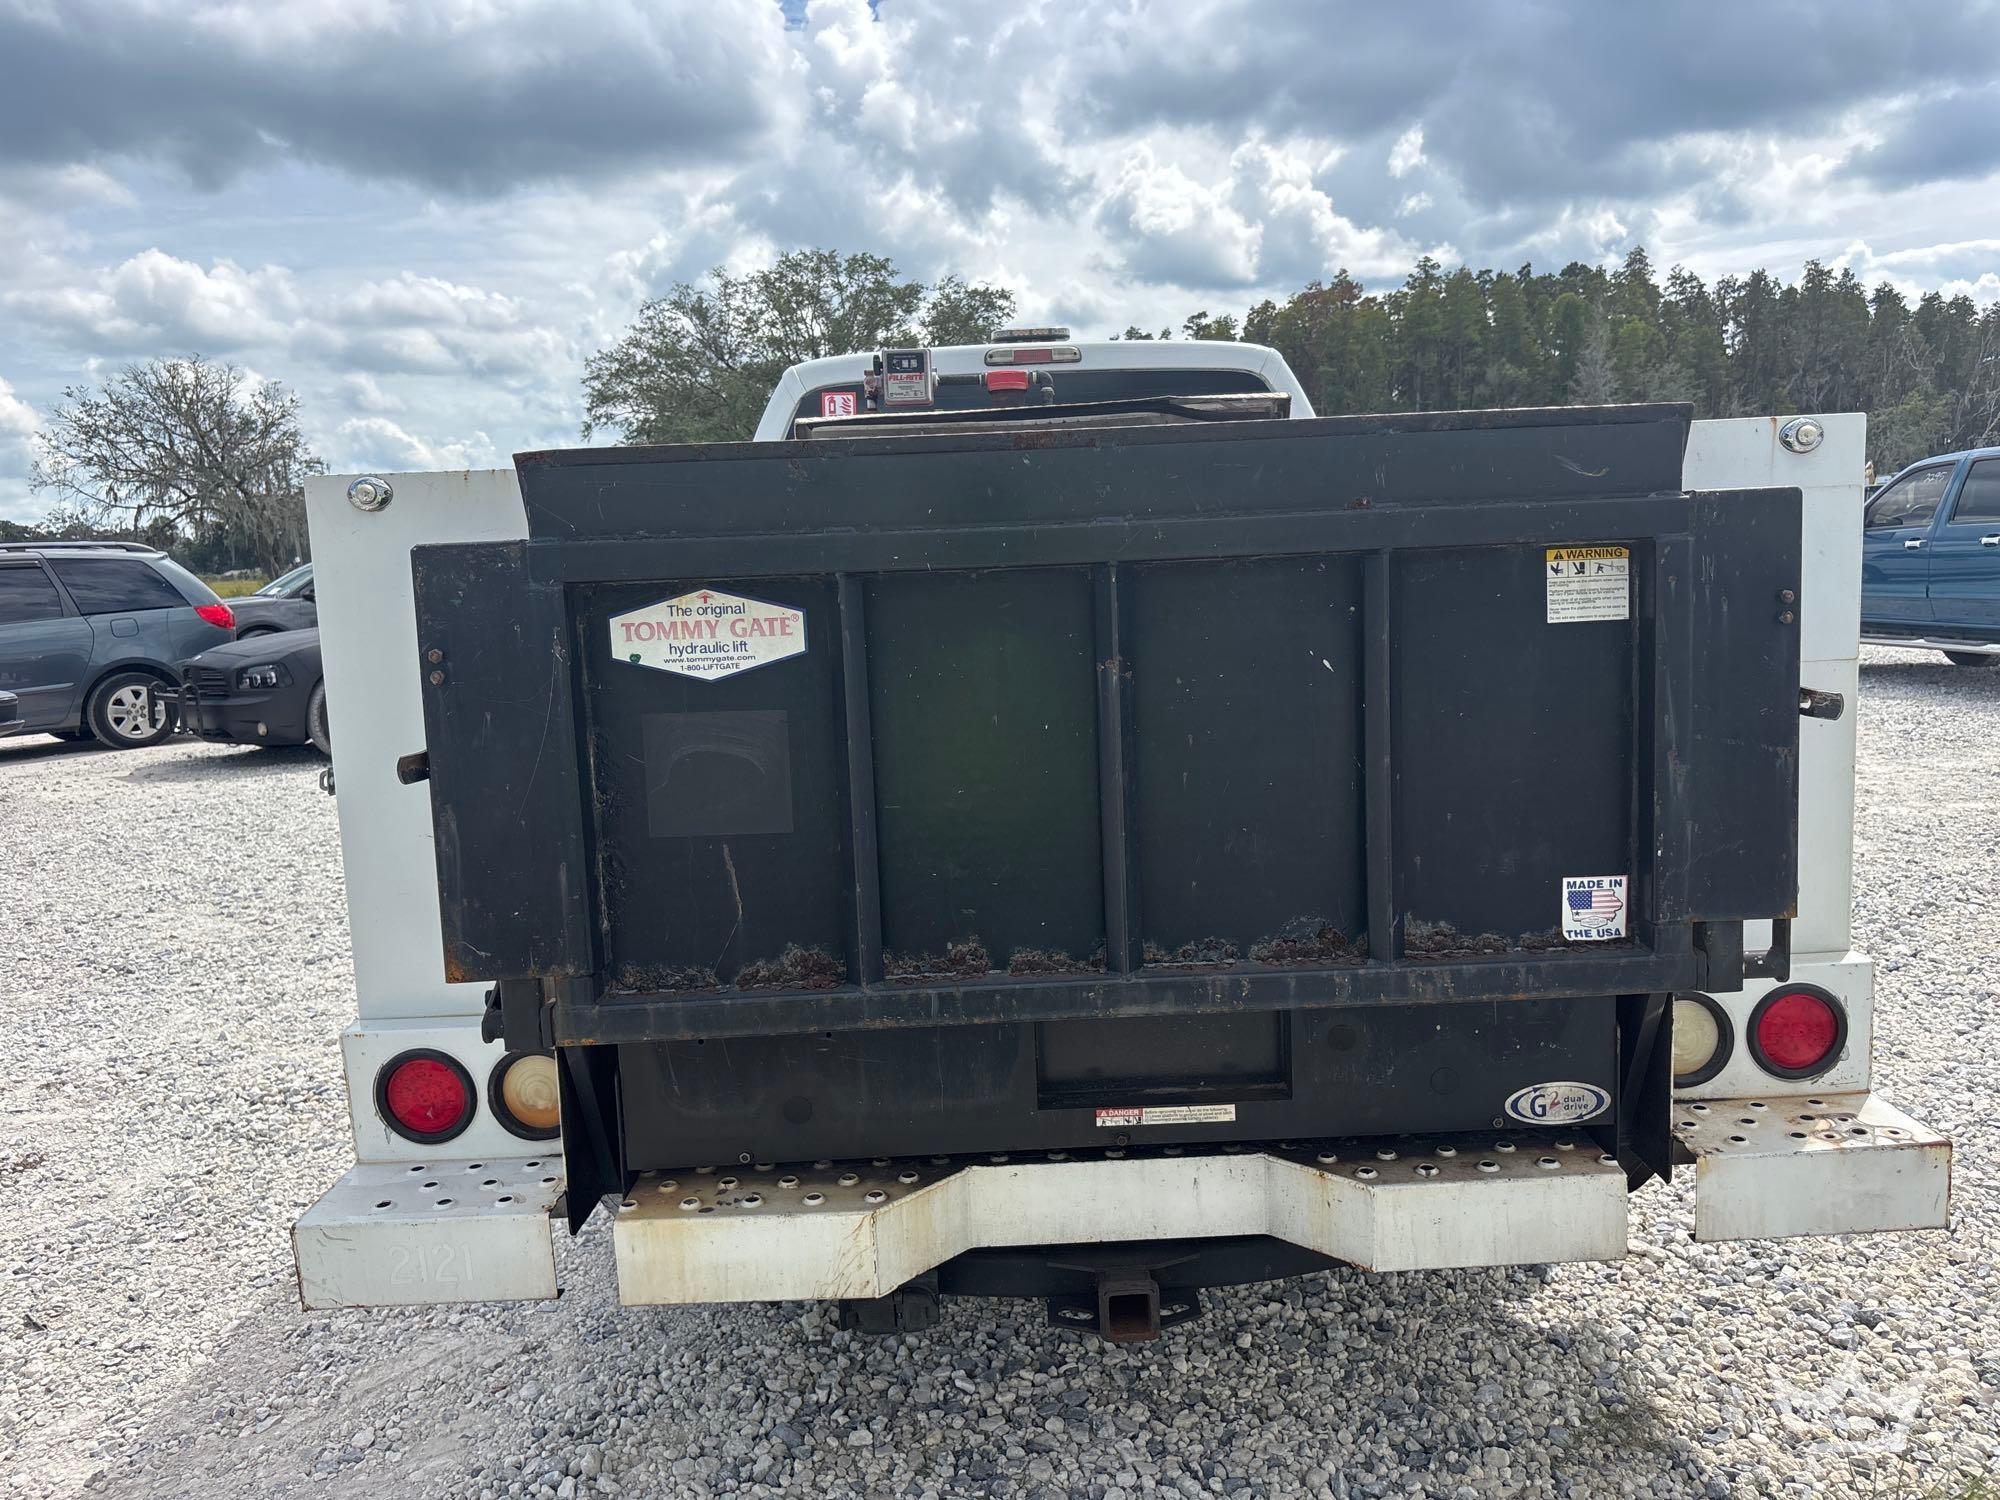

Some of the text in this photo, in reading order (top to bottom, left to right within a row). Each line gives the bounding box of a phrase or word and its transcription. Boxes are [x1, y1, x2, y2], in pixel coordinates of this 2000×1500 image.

[1566, 548, 1622, 559] WARNING
[667, 603, 746, 618] The original
[621, 619, 720, 642] TOMMY
[669, 640, 748, 657] hydraulic lift
[663, 654, 756, 664] www.tommygate.com
[680, 662, 740, 671] 1-800-LIFTGATE
[1566, 879, 1622, 889] MADE IN
[1565, 928, 1622, 939] THE USA
[1563, 1095, 1585, 1103] dual
[390, 1242, 473, 1284] 2121
